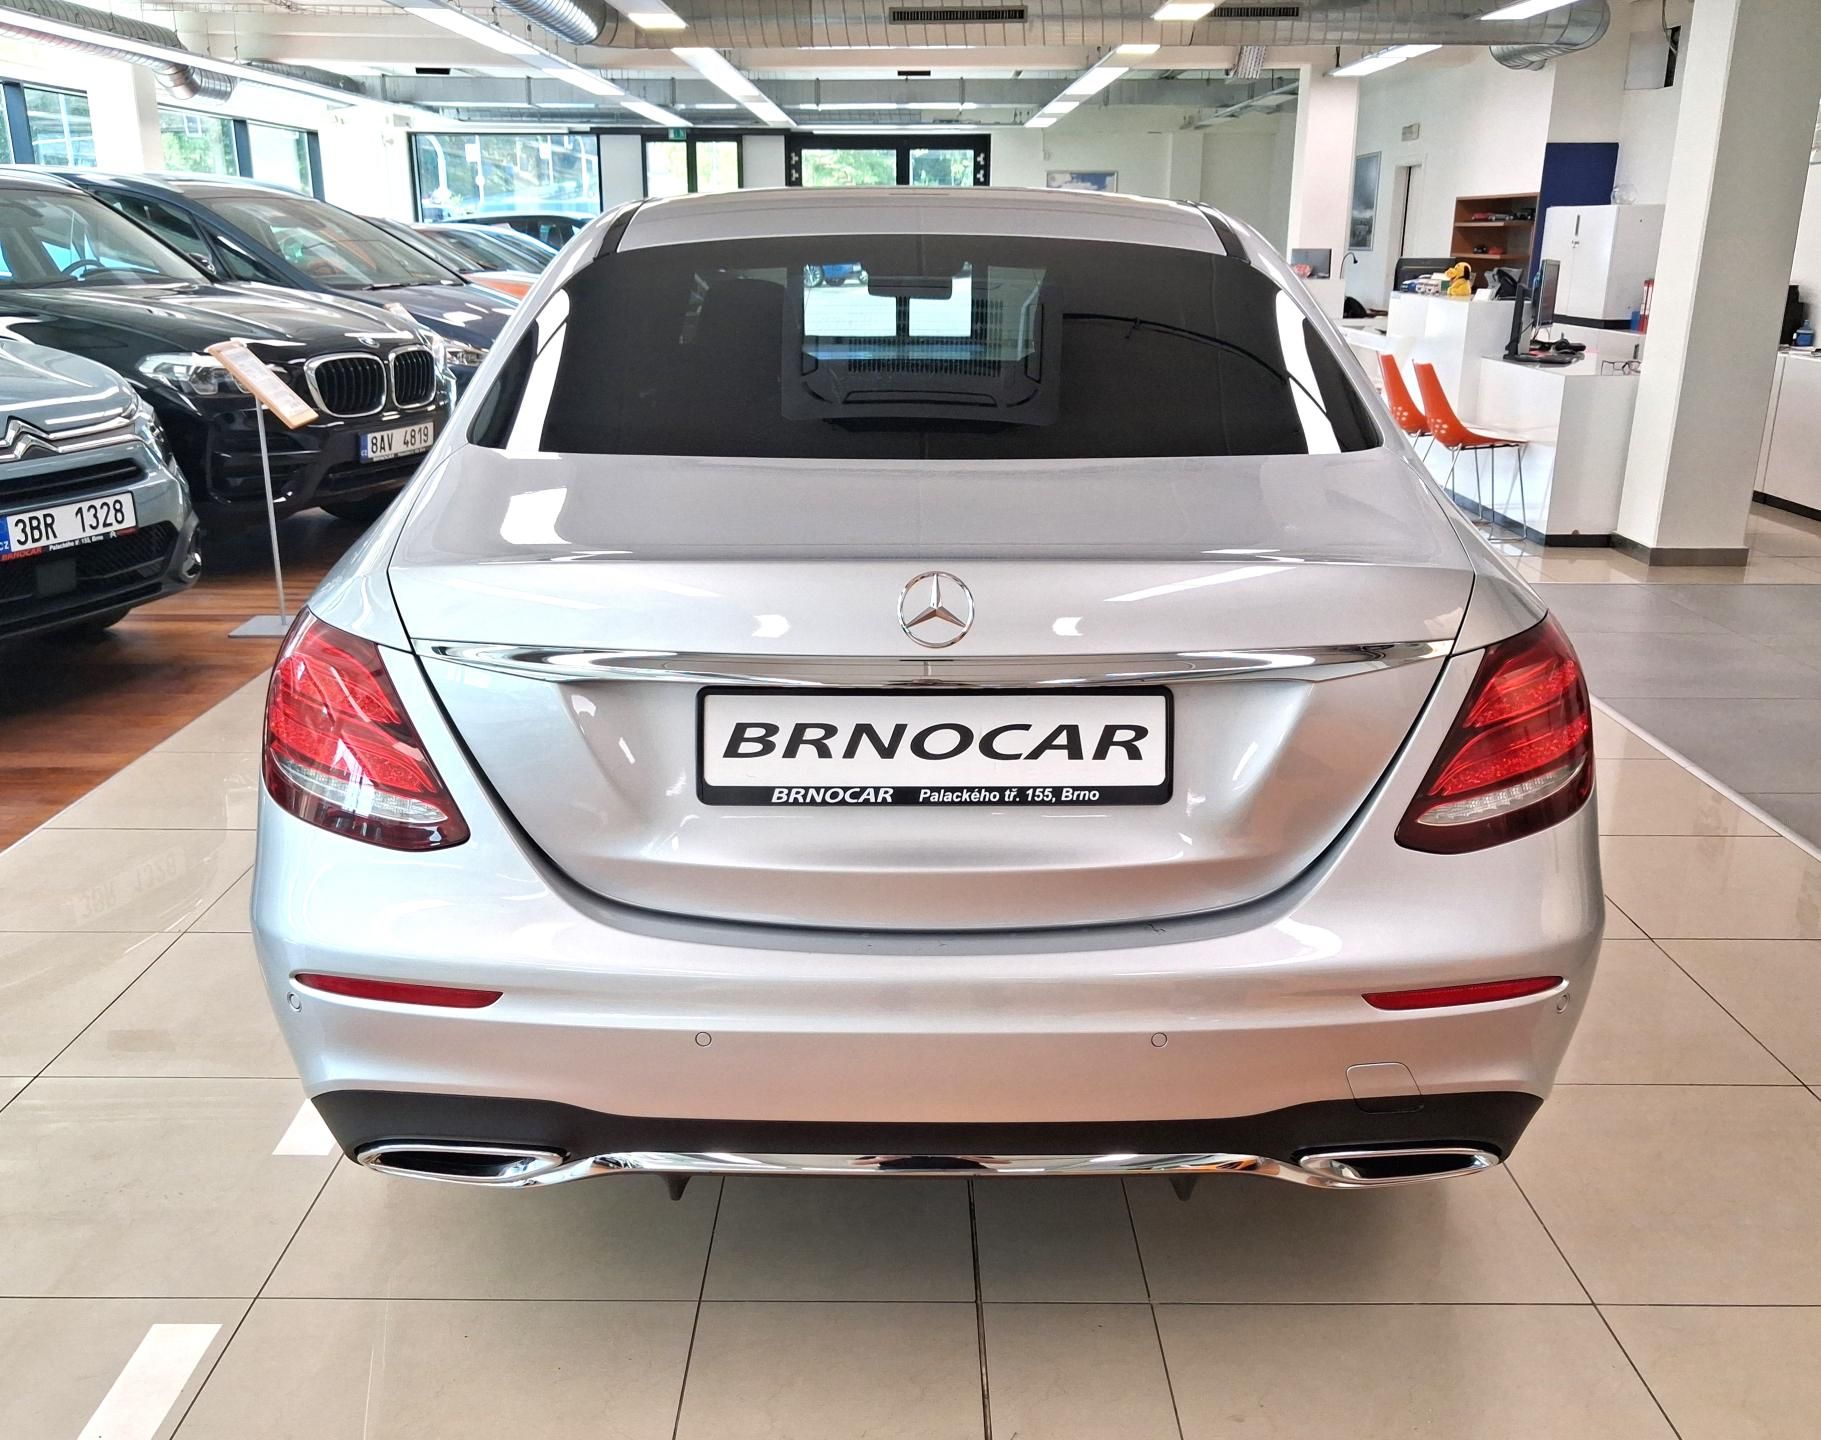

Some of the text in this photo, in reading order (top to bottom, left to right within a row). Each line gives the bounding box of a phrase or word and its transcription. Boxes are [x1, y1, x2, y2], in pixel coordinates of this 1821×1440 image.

[371, 425, 429, 454] 8AV 4819
[14, 499, 125, 546] 3BR 1328
[0, 540, 9, 551] CZ
[722, 722, 1149, 761] BRNOCAR
[771, 787, 1100, 803] BRNOCAR Palackého tř. 155, Brno
